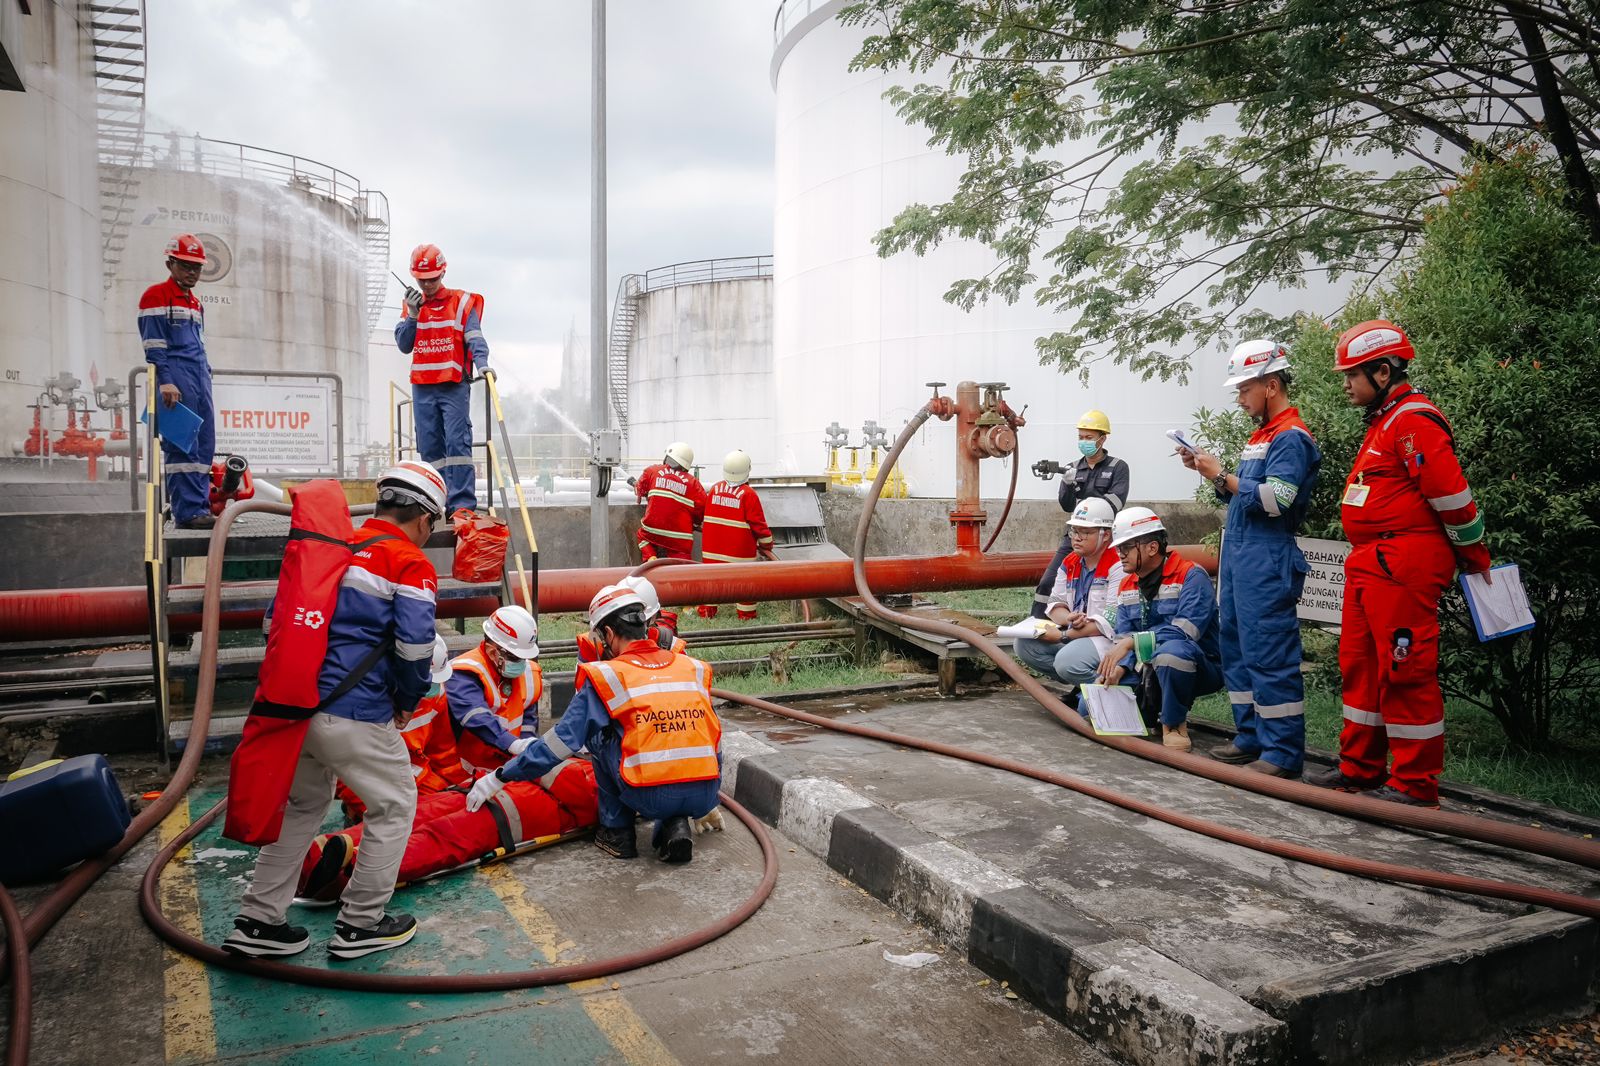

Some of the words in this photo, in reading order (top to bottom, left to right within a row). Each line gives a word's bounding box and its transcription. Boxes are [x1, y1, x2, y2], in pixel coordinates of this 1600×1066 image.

[413, 344, 454, 354] COMMANDER
[6, 370, 20, 381] OUT
[220, 410, 310, 429] TERTUTUP
[636, 709, 705, 724] EVACUATION
[653, 721, 687, 733] TEAM
[691, 721, 696, 730] 1
